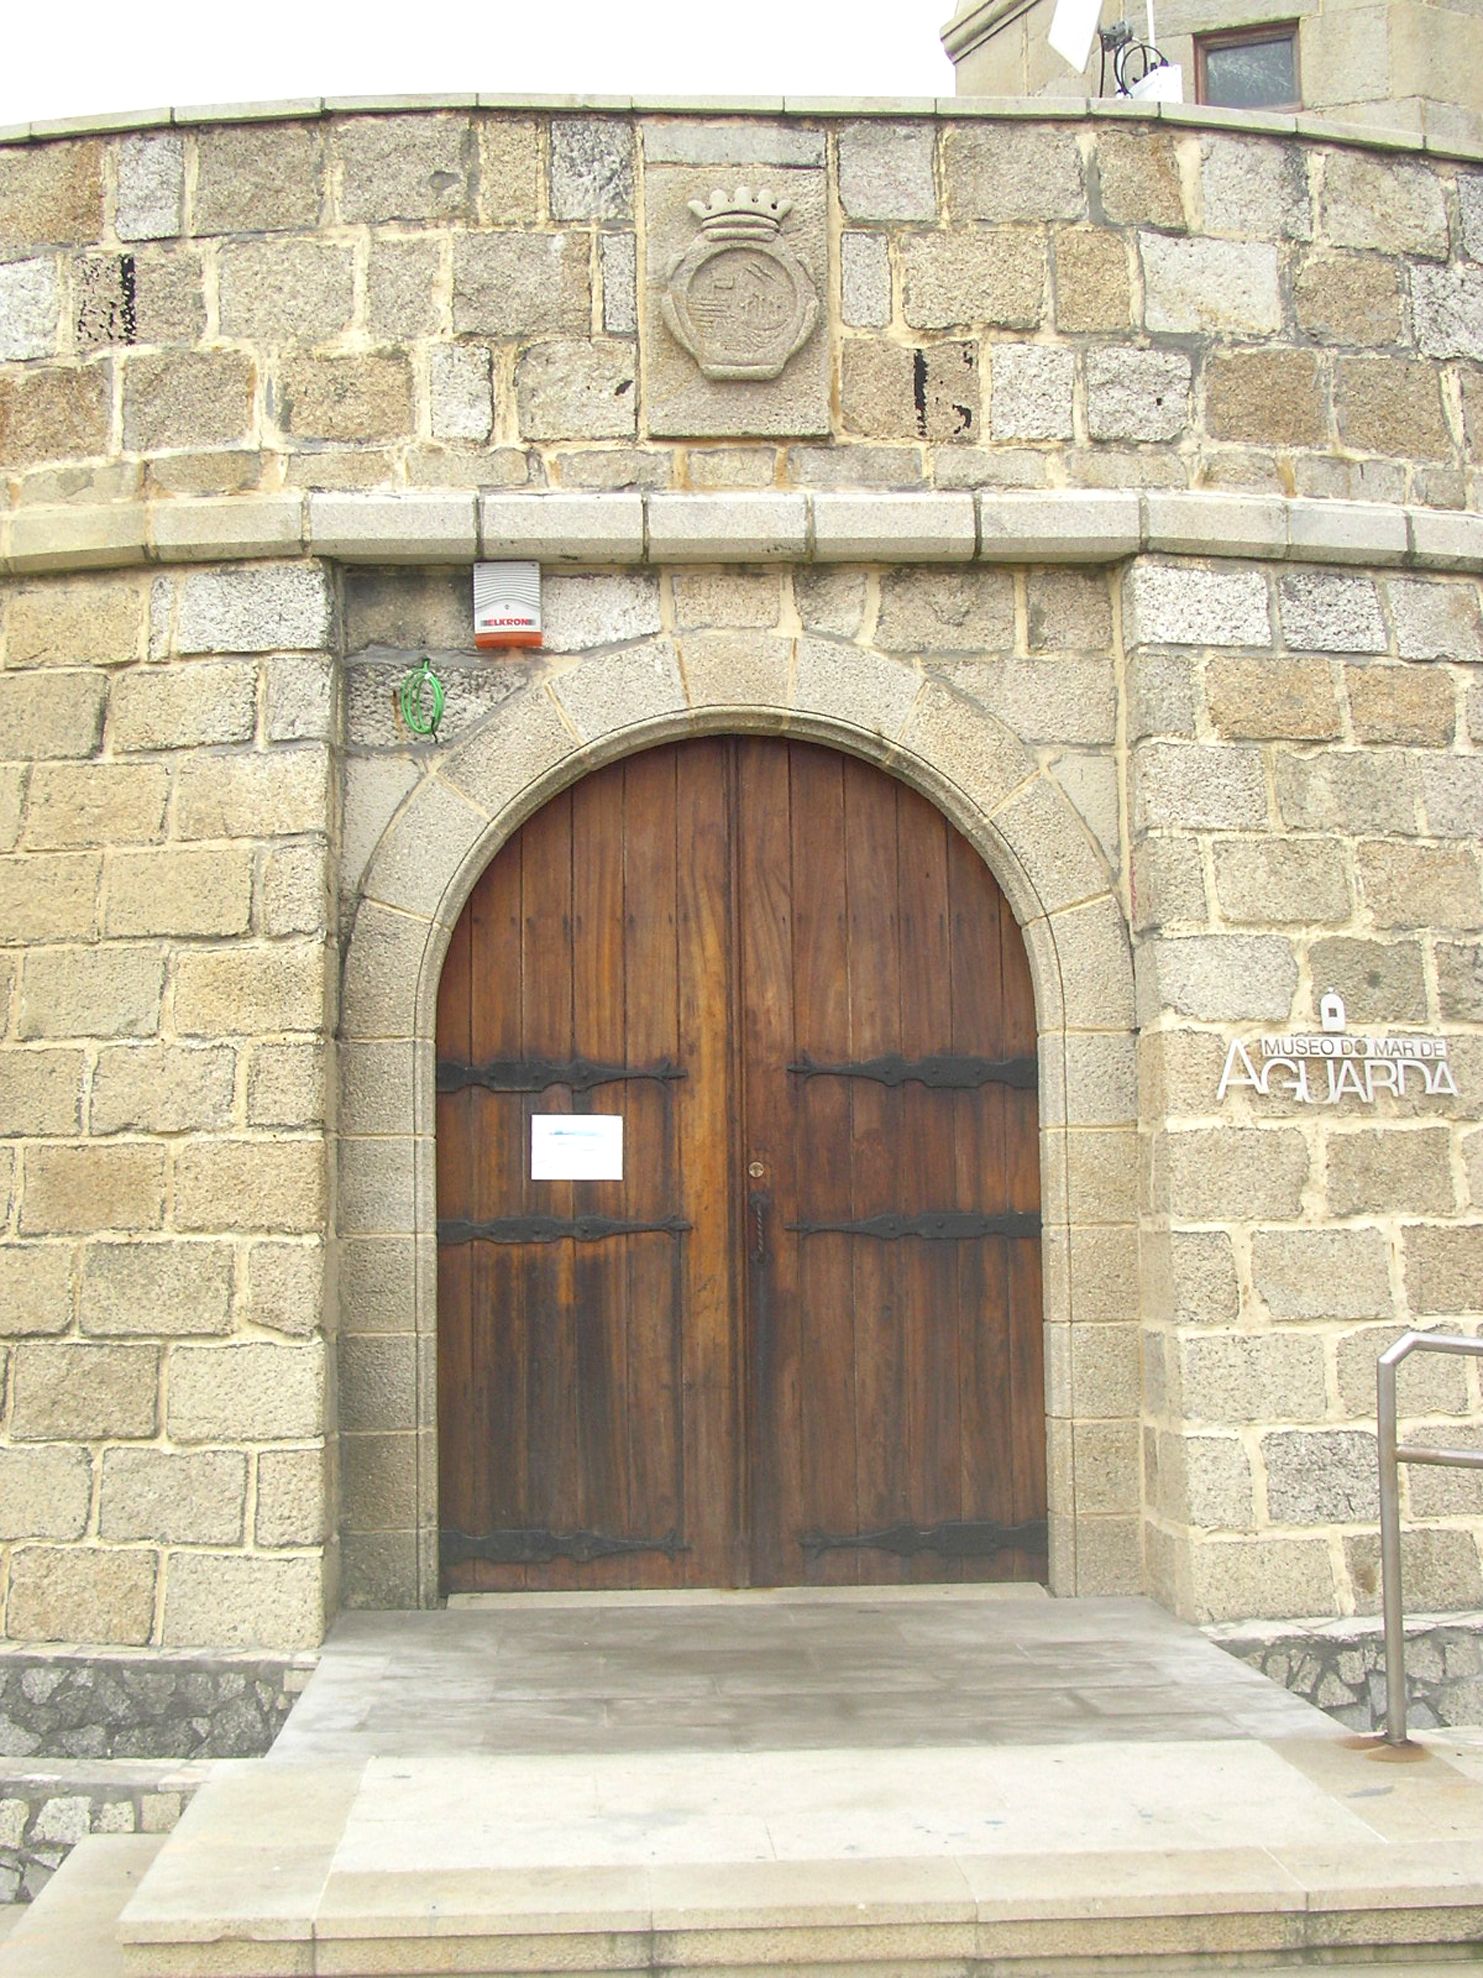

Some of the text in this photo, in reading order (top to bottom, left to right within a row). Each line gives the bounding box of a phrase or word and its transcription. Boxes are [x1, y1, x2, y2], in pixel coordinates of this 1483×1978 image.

[487, 618, 529, 626] ELKRON
[1264, 1039, 1445, 1057] MUSEO DO MAR DE
